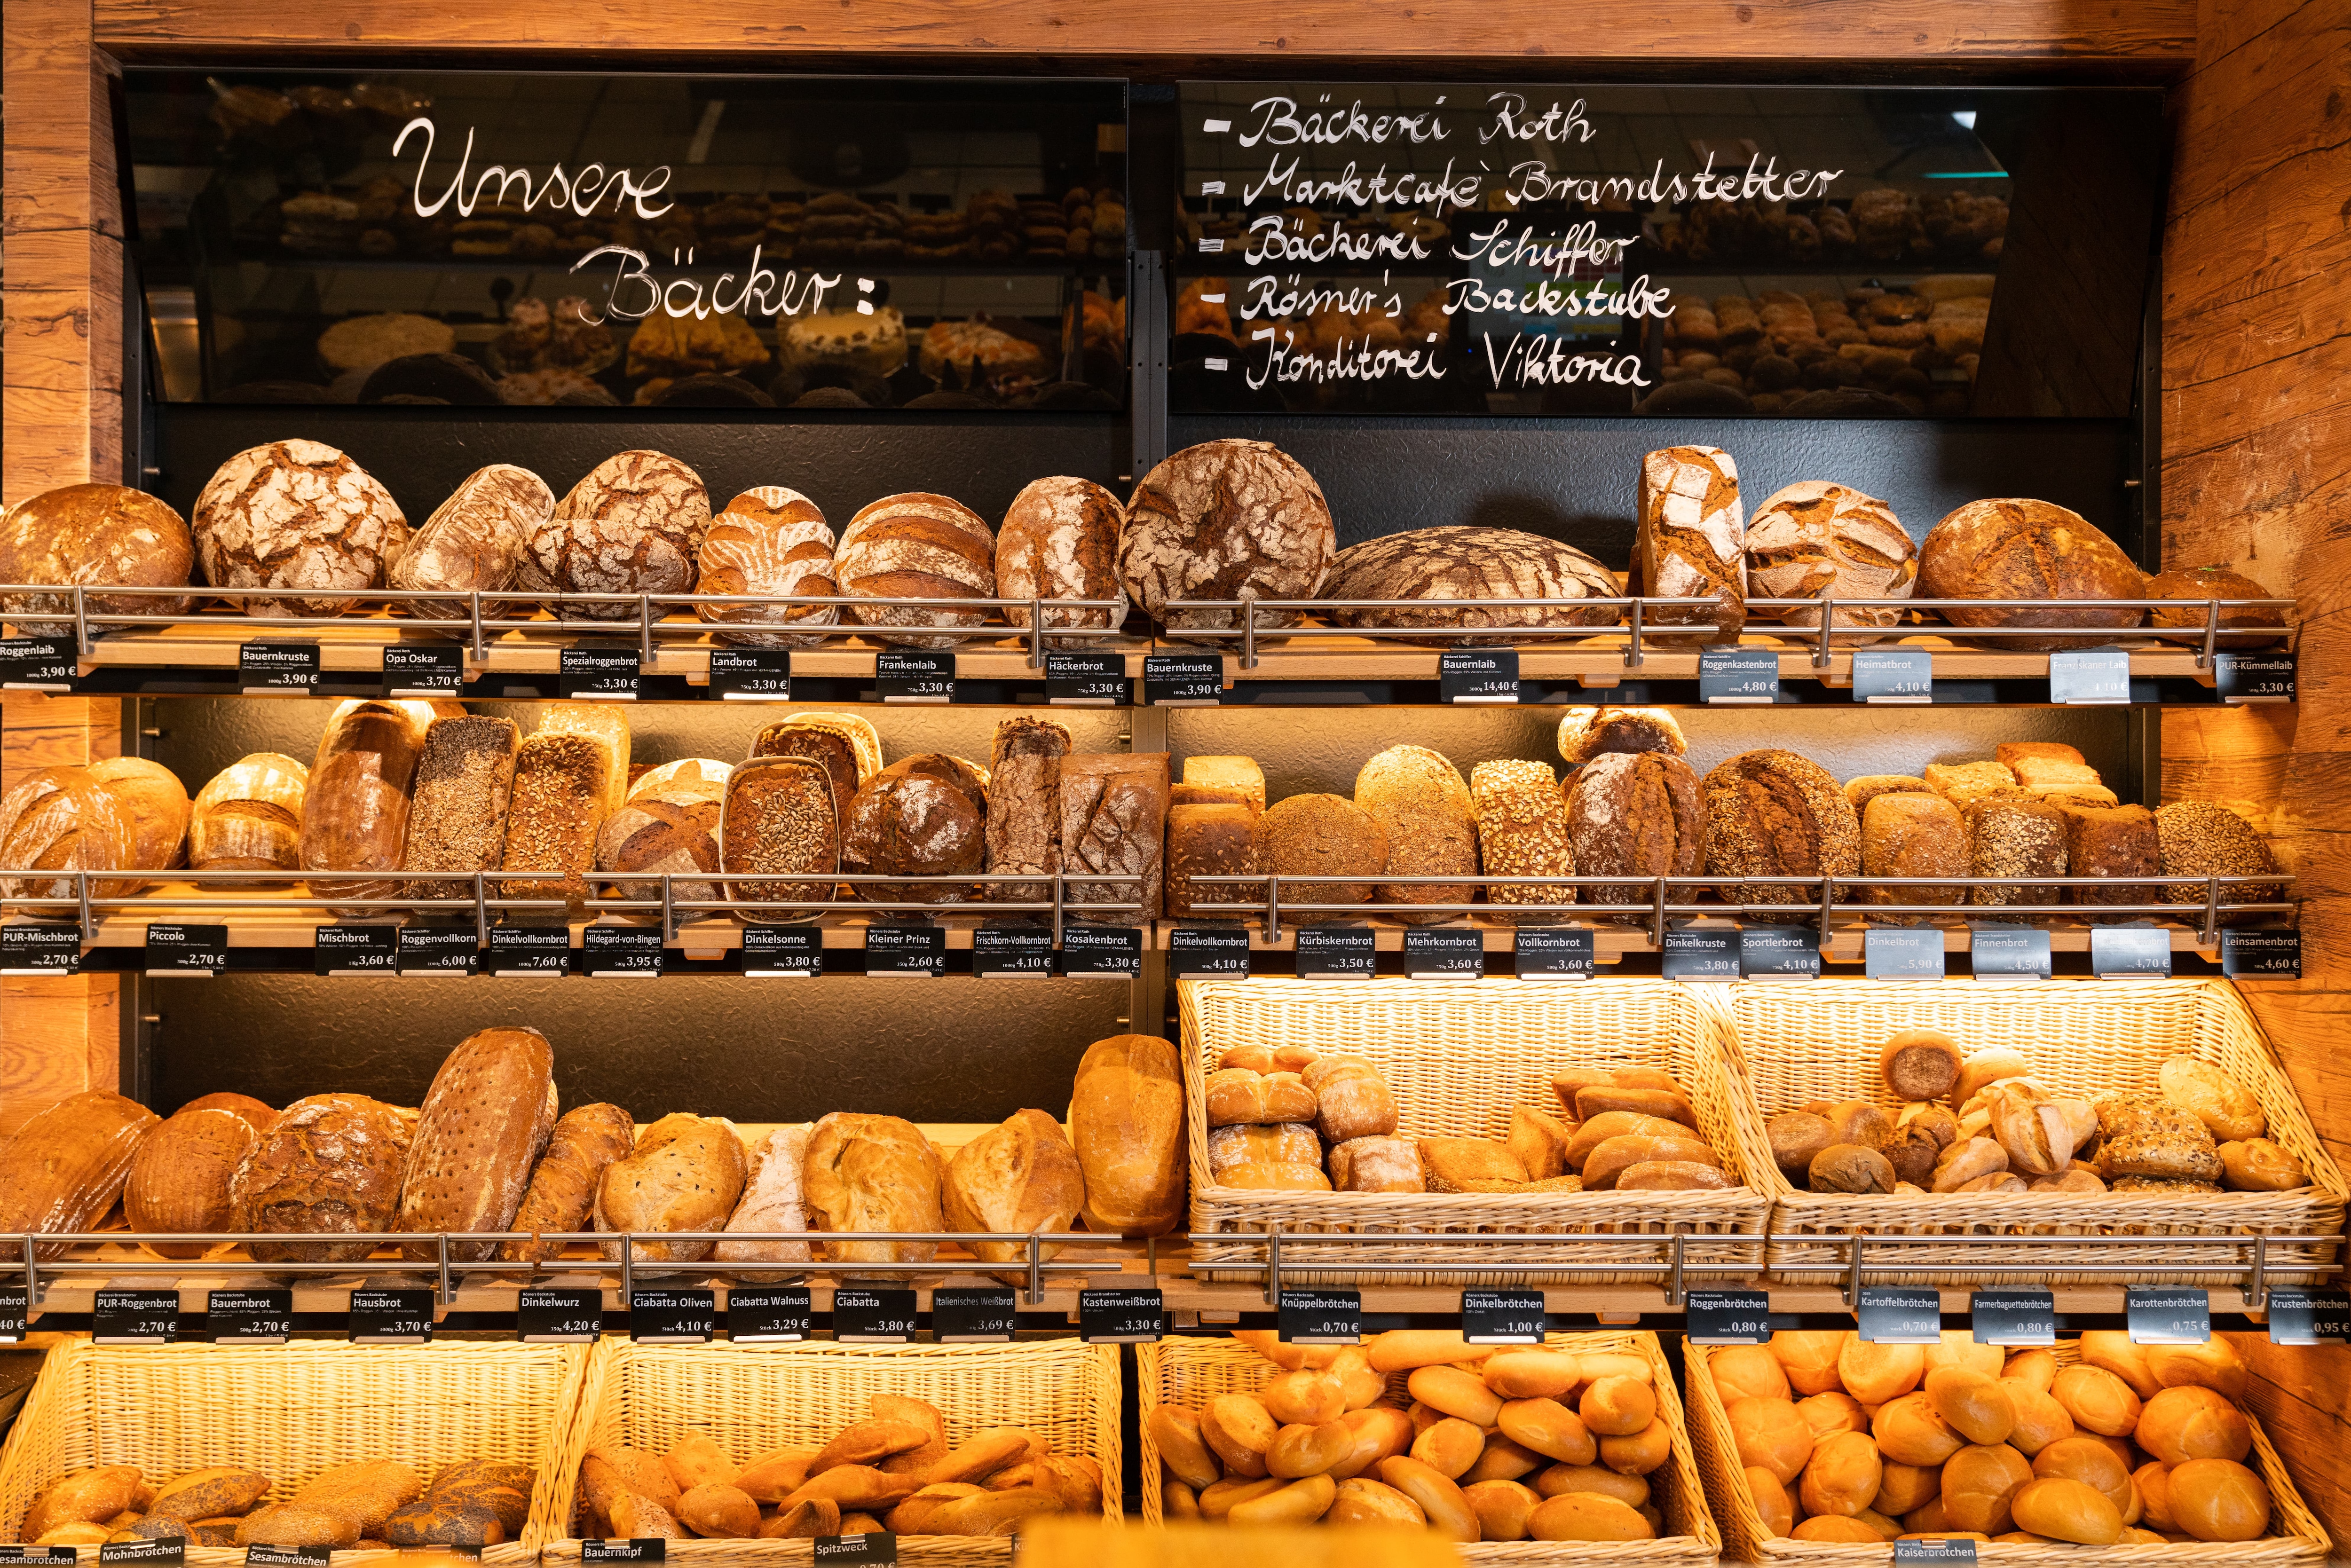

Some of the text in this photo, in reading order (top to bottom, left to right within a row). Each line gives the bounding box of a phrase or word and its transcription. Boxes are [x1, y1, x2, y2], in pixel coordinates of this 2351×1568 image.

[1239, 92, 1596, 147] Bäckerei Roth
[393, 118, 674, 220] Unsere
[1506, 151, 1844, 205] Brandstetter
[1245, 216, 1644, 280] Bäckerei Schiffer
[569, 244, 874, 326] Bäcker:
[1442, 272, 1676, 318] Backstube
[1247, 327, 1651, 389] Konditorei Viktoria
[0, 645, 55, 657] Roggenlaib
[243, 652, 309, 661] Bauernkruste
[387, 654, 437, 664] Opa Oskar
[563, 656, 637, 667] Spezialroggenbrot
[713, 657, 757, 666] Landbrot
[880, 661, 936, 669] Frankenlaib
[1049, 662, 1103, 670] Häckerbrot
[1147, 663, 1212, 672] Bauernkruste
[1444, 660, 1495, 668] Bauernlaib
[1703, 660, 1776, 670] Roggenkastenbrot
[2220, 661, 2292, 670] PUR-Kümmellaib
[283, 674, 317, 684] 3,90 €
[426, 677, 461, 686] 3,70 €
[919, 683, 953, 693] 3,30 €
[1188, 685, 1221, 695] 3,90 €
[1484, 682, 1508, 692] 14,40
[1511, 682, 1517, 690] €
[1743, 682, 1776, 692] 4,80 €
[3, 932, 78, 941] PUR-Mischbrot
[150, 931, 184, 940] Piccolo
[319, 933, 369, 942] Mischbrot
[402, 934, 476, 945] Roggenvollkorn
[493, 935, 567, 943] Dinkelvollkornbrot
[587, 934, 660, 945] Hildegard-von-Bingen
[746, 935, 805, 943] Dinkelsonne
[869, 934, 903, 943] Kleiner
[977, 936, 1050, 944] Frischkorn-Vollkornbrot
[1066, 935, 1127, 945] Kosakenbrot
[1300, 936, 1372, 945] Kürbiskernbrot
[1174, 937, 1247, 946] Dinkelvollkornbrot
[1518, 938, 1580, 946] Vollkornbrot
[1666, 938, 1726, 947] Dinkelkruste
[1743, 938, 1803, 948] Sportlerbrot
[2225, 938, 2297, 946] Leinsamenbrot
[189, 954, 224, 965] 2,70 €
[442, 956, 476, 966] 6,00 €
[533, 957, 567, 967] 7,60 €
[627, 957, 650, 967] 3,95
[654, 957, 661, 966] €
[786, 957, 809, 967] 3,80
[813, 957, 820, 966] €
[909, 957, 943, 967] 2,60 €
[1105, 958, 1139, 968] 3,30 €
[1340, 958, 1373, 969] 3,50 €
[2265, 959, 2299, 969] 4,60 €
[1559, 960, 1592, 970] 3,60 €
[98, 1299, 177, 1309] PUR-Roggenbrot
[212, 1298, 270, 1308] Bauernbrot
[354, 1298, 401, 1307] Hausbrot
[522, 1298, 579, 1306] Dinkelwurz
[634, 1298, 712, 1307] Ciabatta Oliven
[731, 1296, 808, 1306] Ciabatta Walnuss
[837, 1297, 879, 1306] Ciabatta
[937, 1297, 1013, 1306] Italienisches Weißbrot
[1083, 1297, 1160, 1306] Kastenweißbrot
[1282, 1299, 1358, 1309] Knüppelbrötchen
[1466, 1299, 1542, 1308] Dinkelbrötchen
[1690, 1299, 1767, 1309] Roggenbrötchen
[1862, 1297, 1937, 1308] Kartoffelbrötchen
[1975, 1300, 2051, 1310] Farmerbaguettebrötchen
[2130, 1298, 2207, 1307] Karottenbrötchen
[2272, 1300, 2348, 1308] Krustenbrötchen
[252, 1322, 289, 1332] 2,70 €
[563, 1321, 588, 1332] 4,20
[592, 1321, 599, 1330] €
[676, 1321, 700, 1332] 4,10
[704, 1322, 711, 1331] €
[773, 1319, 797, 1330] 3,29
[801, 1319, 808, 1328] €
[878, 1321, 914, 1332] 3,80 €
[1126, 1320, 1160, 1331] 3,30 €
[1324, 1322, 1358, 1333] 0,70 €
[1508, 1322, 1543, 1332] 1,00 €
[1732, 1322, 1767, 1332] 0,80 €
[103, 1545, 181, 1560] Mohnbrötchen
[585, 1546, 642, 1558] Bauernkipf
[817, 1542, 868, 1555] Spitzweck
[249, 1552, 326, 1566] Sesambrötchen
